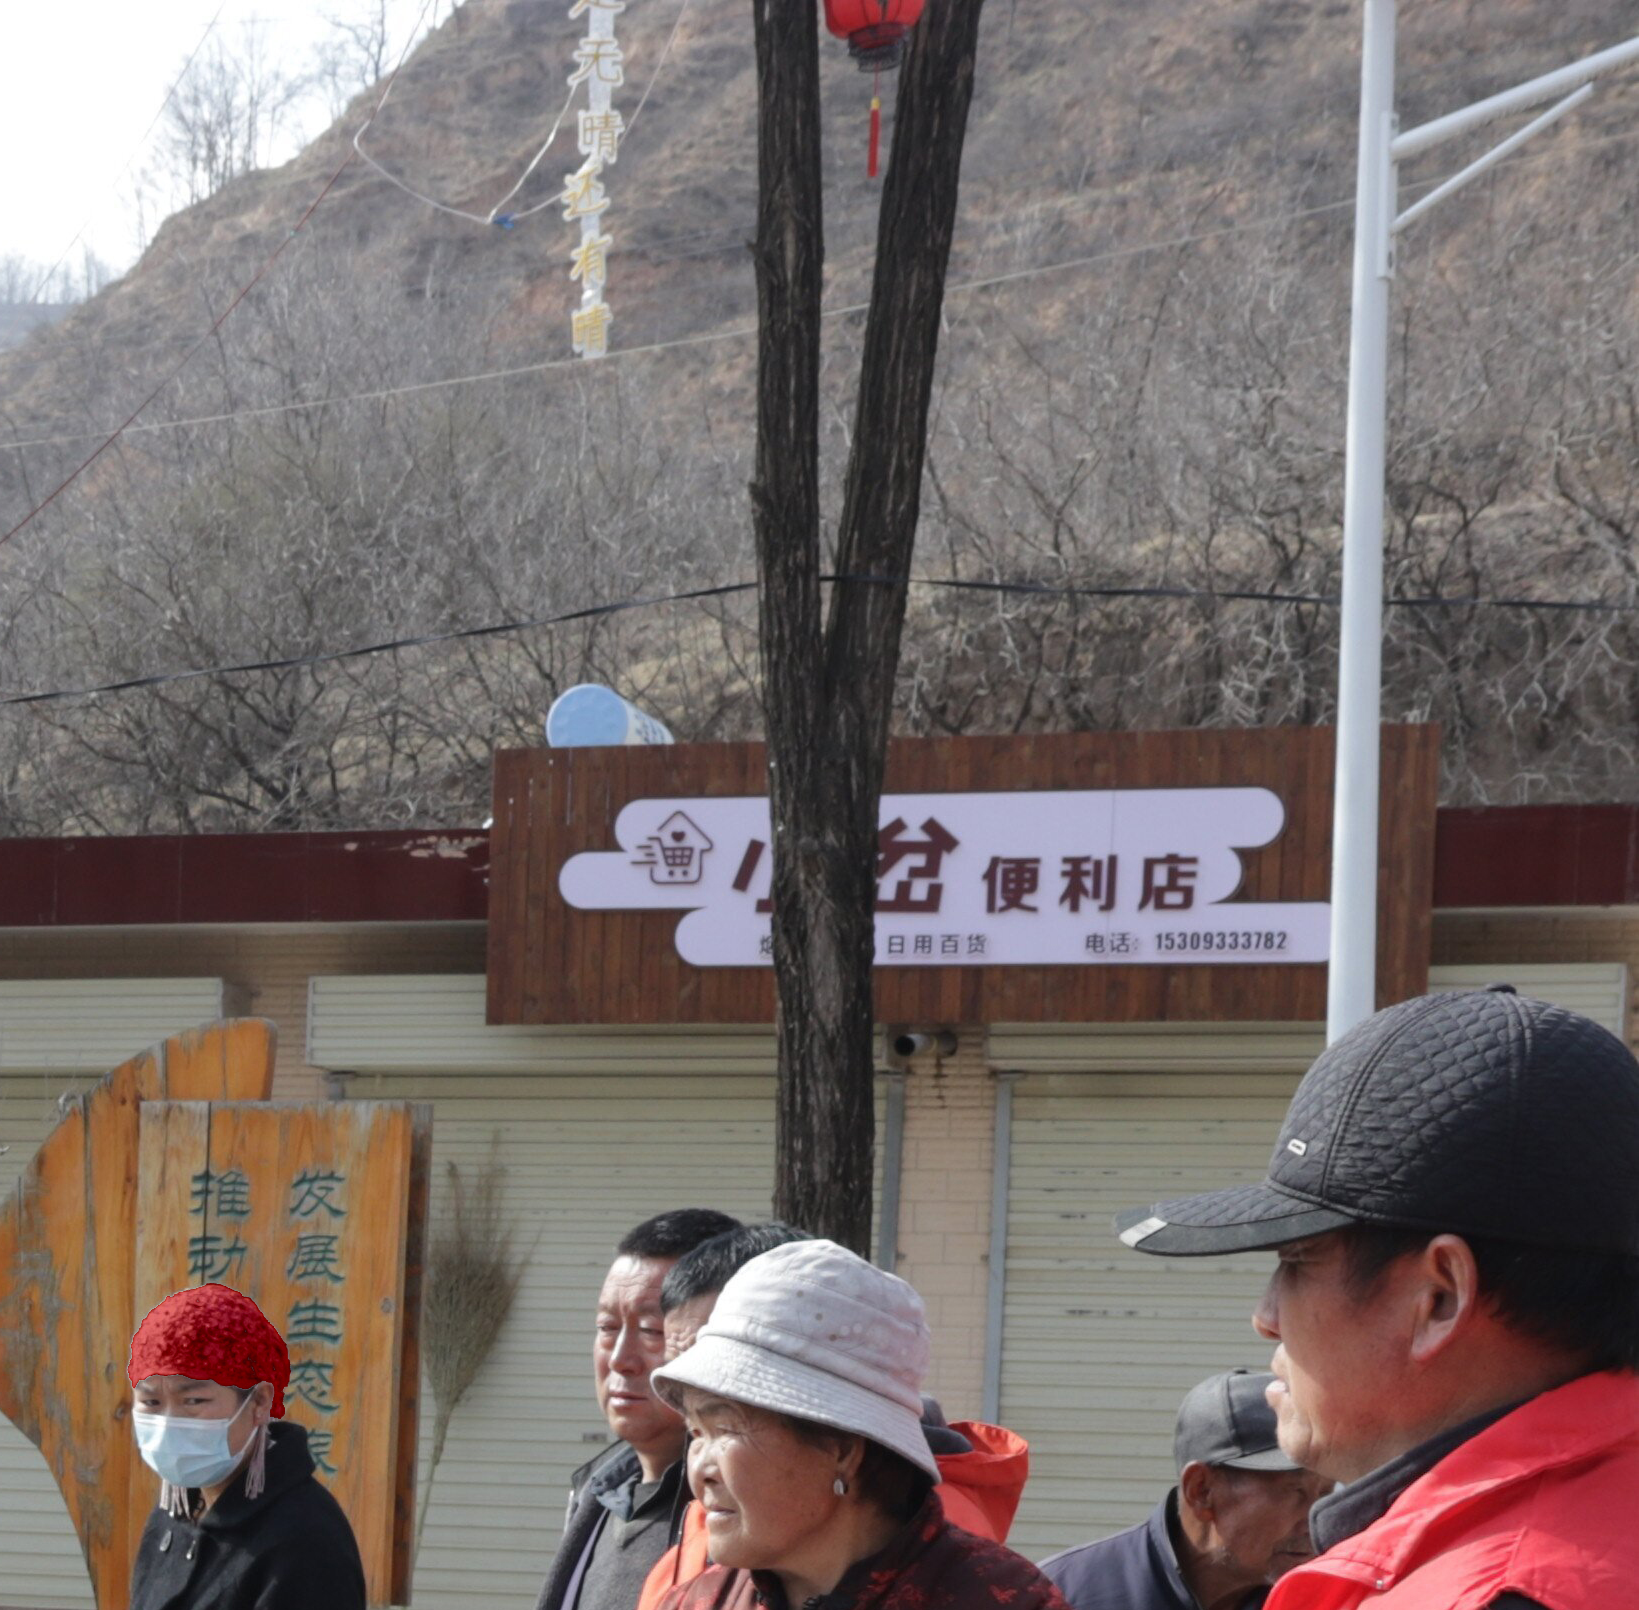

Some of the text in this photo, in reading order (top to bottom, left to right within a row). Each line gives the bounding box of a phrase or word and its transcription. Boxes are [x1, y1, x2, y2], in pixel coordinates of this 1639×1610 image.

[563, 0, 625, 355] 无晴还有晴
[982, 854, 1199, 912] 便利店
[887, 934, 987, 955] 日用百货
[1156, 932, 1288, 950] 15309333782
